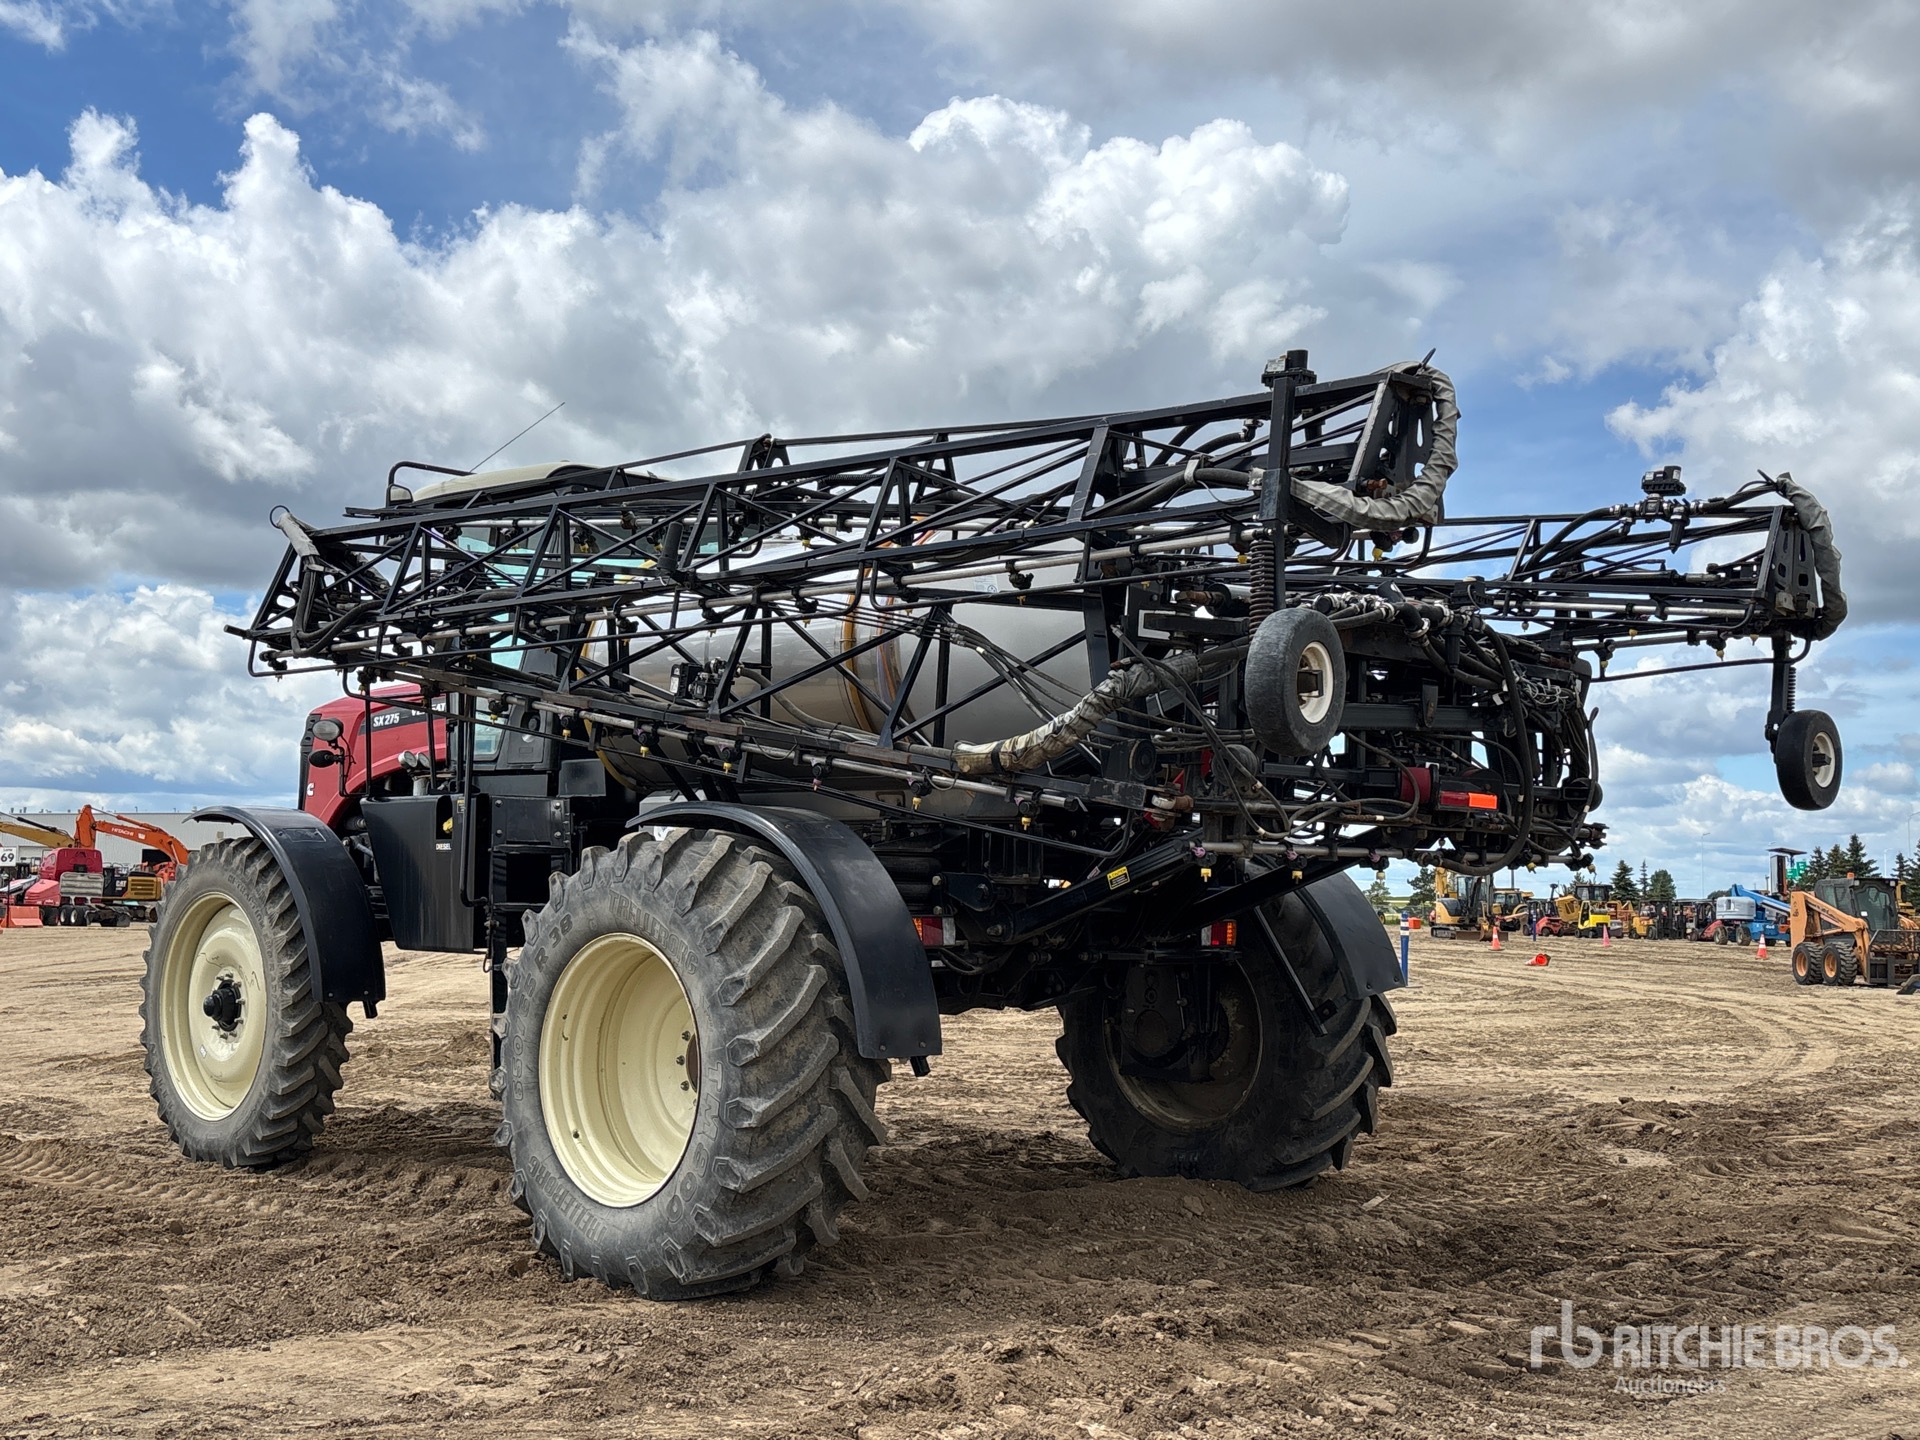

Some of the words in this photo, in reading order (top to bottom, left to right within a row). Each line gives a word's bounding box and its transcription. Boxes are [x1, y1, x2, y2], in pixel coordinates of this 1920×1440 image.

[1, 853, 15, 863] 69
[549, 913, 574, 949] 38
[608, 888, 699, 976] TRELLEBORG
[664, 1060, 724, 1224] TM800
[526, 1155, 608, 1244] TRELLEBORG
